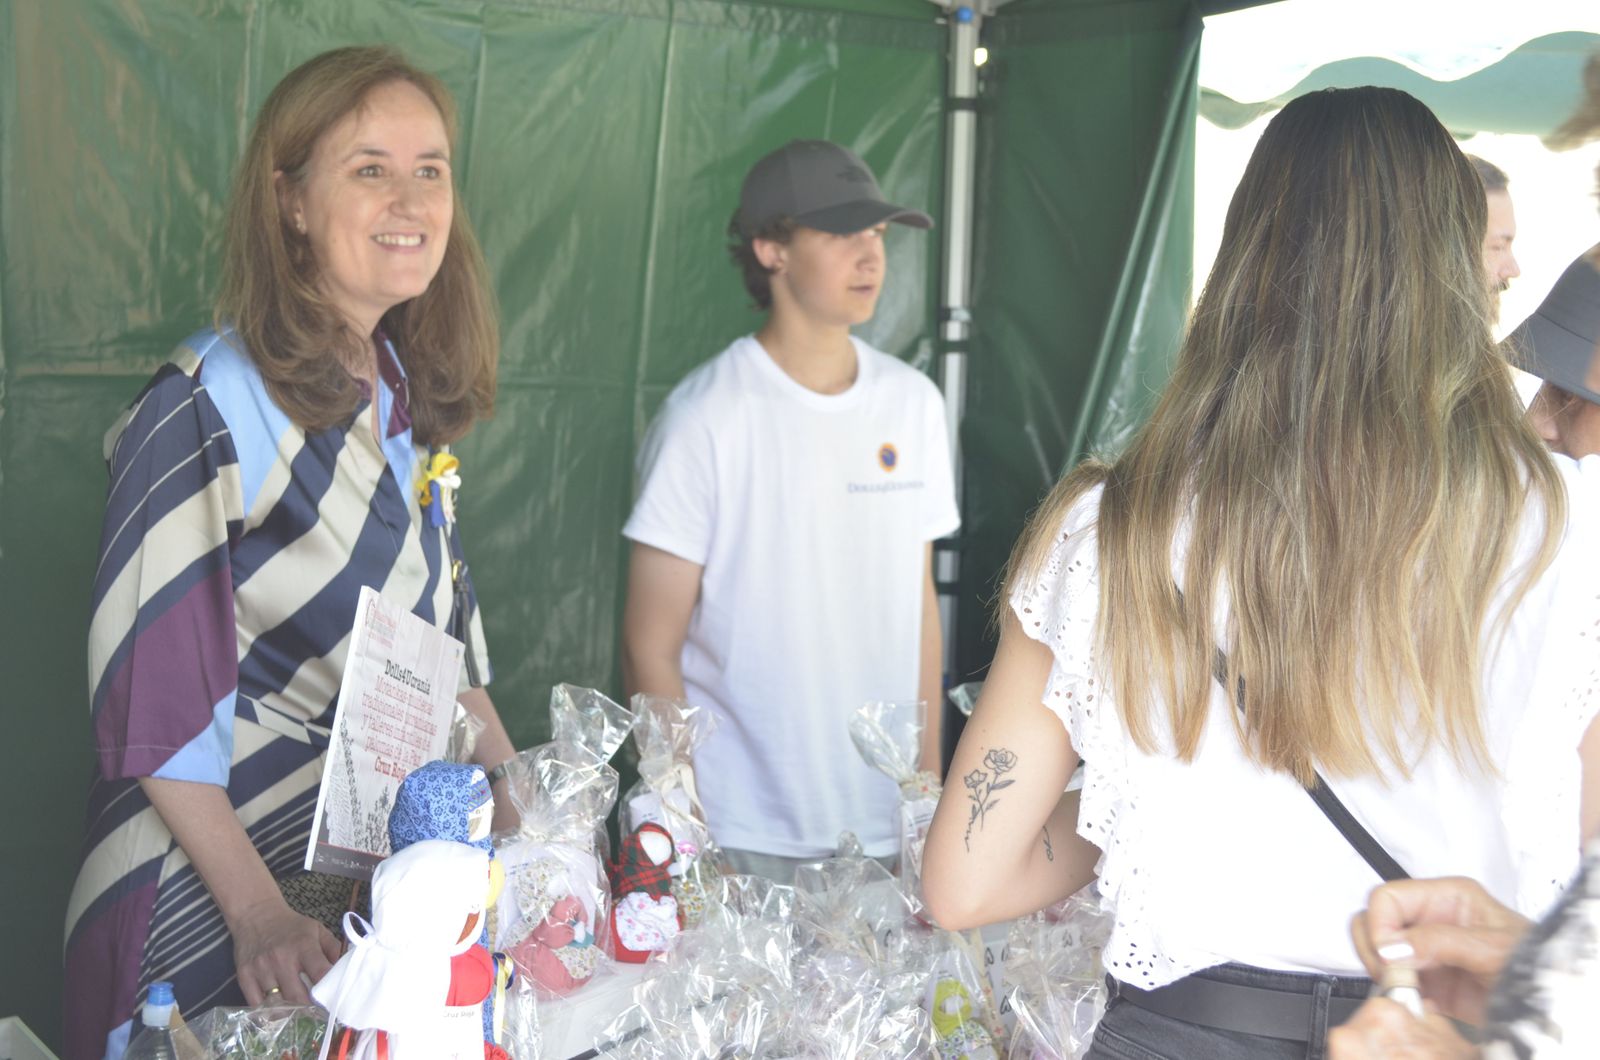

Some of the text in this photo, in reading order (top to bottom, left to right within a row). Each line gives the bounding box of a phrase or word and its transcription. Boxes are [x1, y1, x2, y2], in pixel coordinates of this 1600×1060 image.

[385, 659, 430, 695] Dolls4Ucrania
[362, 691, 404, 721] tradicionales
[361, 714, 369, 730] y
[368, 714, 394, 737] talleres
[365, 734, 394, 757] palomas
[375, 755, 391, 776] Cruz
